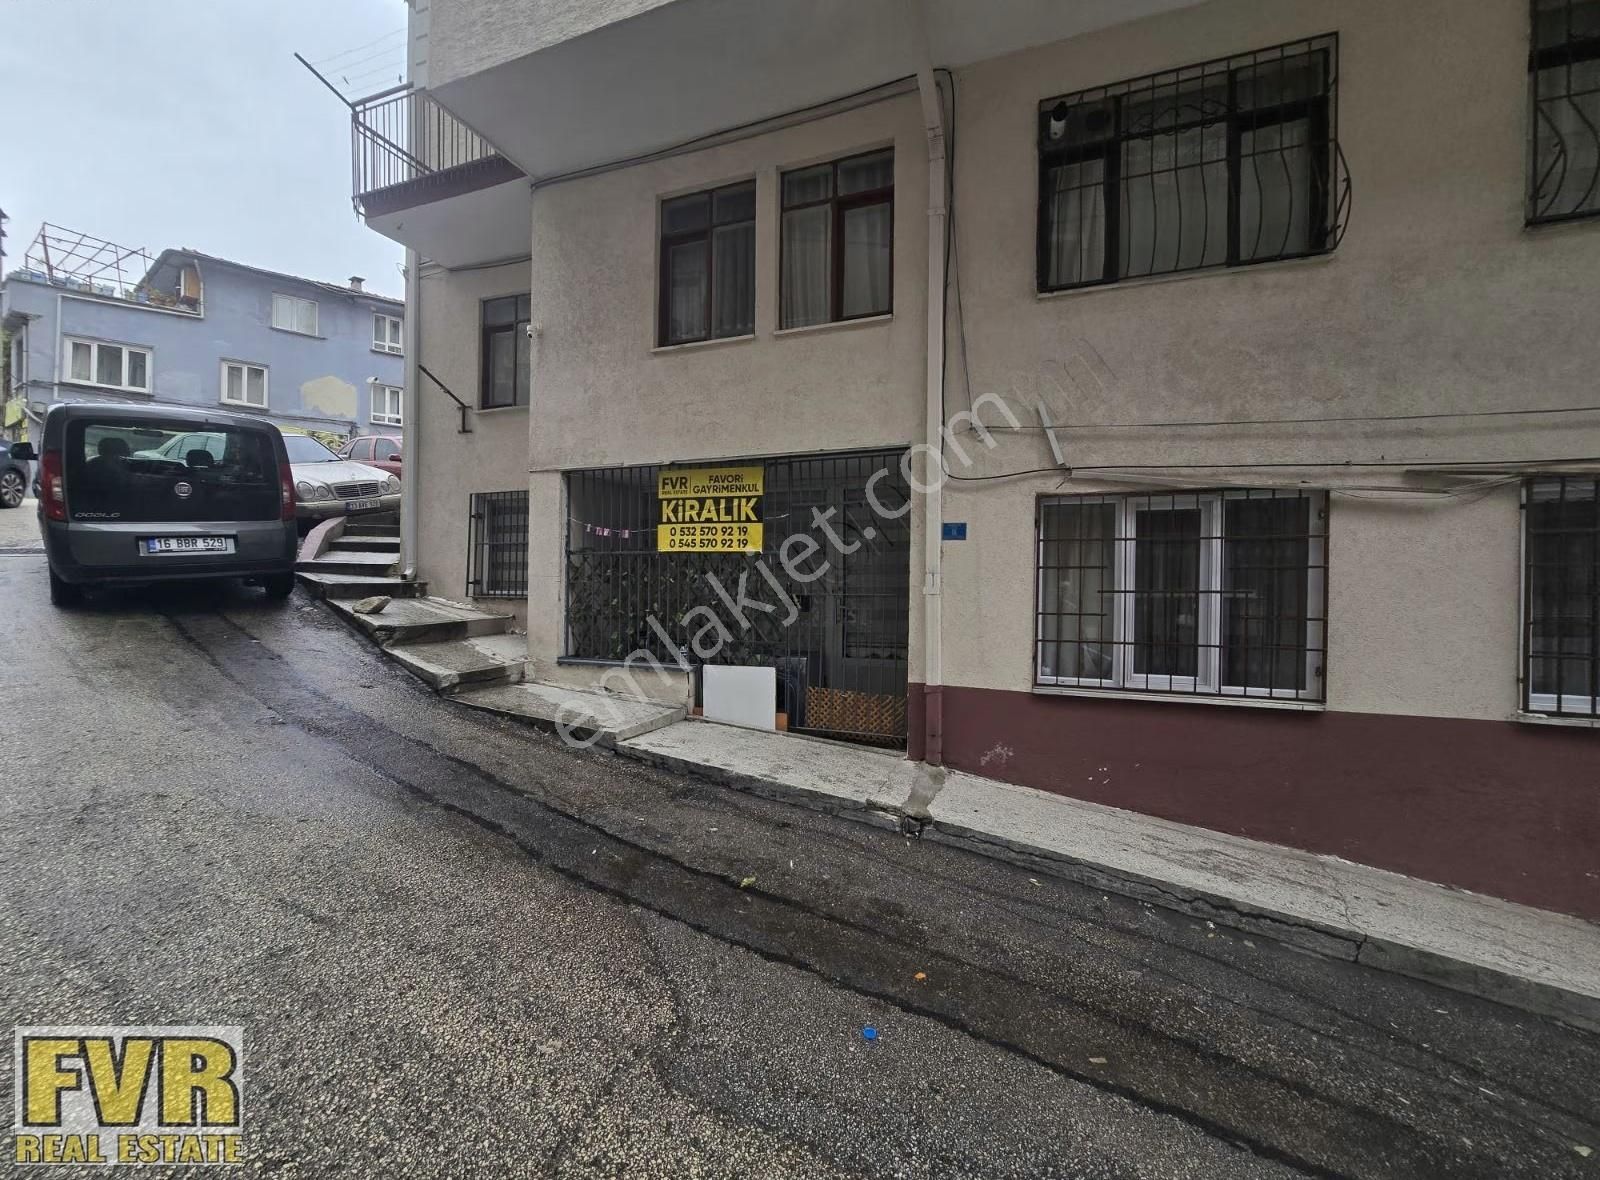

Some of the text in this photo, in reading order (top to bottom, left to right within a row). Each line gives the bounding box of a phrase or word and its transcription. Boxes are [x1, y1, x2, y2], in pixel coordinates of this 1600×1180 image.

[662, 476, 688, 490] FVR
[669, 526, 748, 537] 0 532 570 92 19
[157, 538, 171, 549] 16
[176, 538, 198, 548] BBR
[202, 538, 224, 547] 529
[669, 538, 749, 549] 0 545 570 92 19
